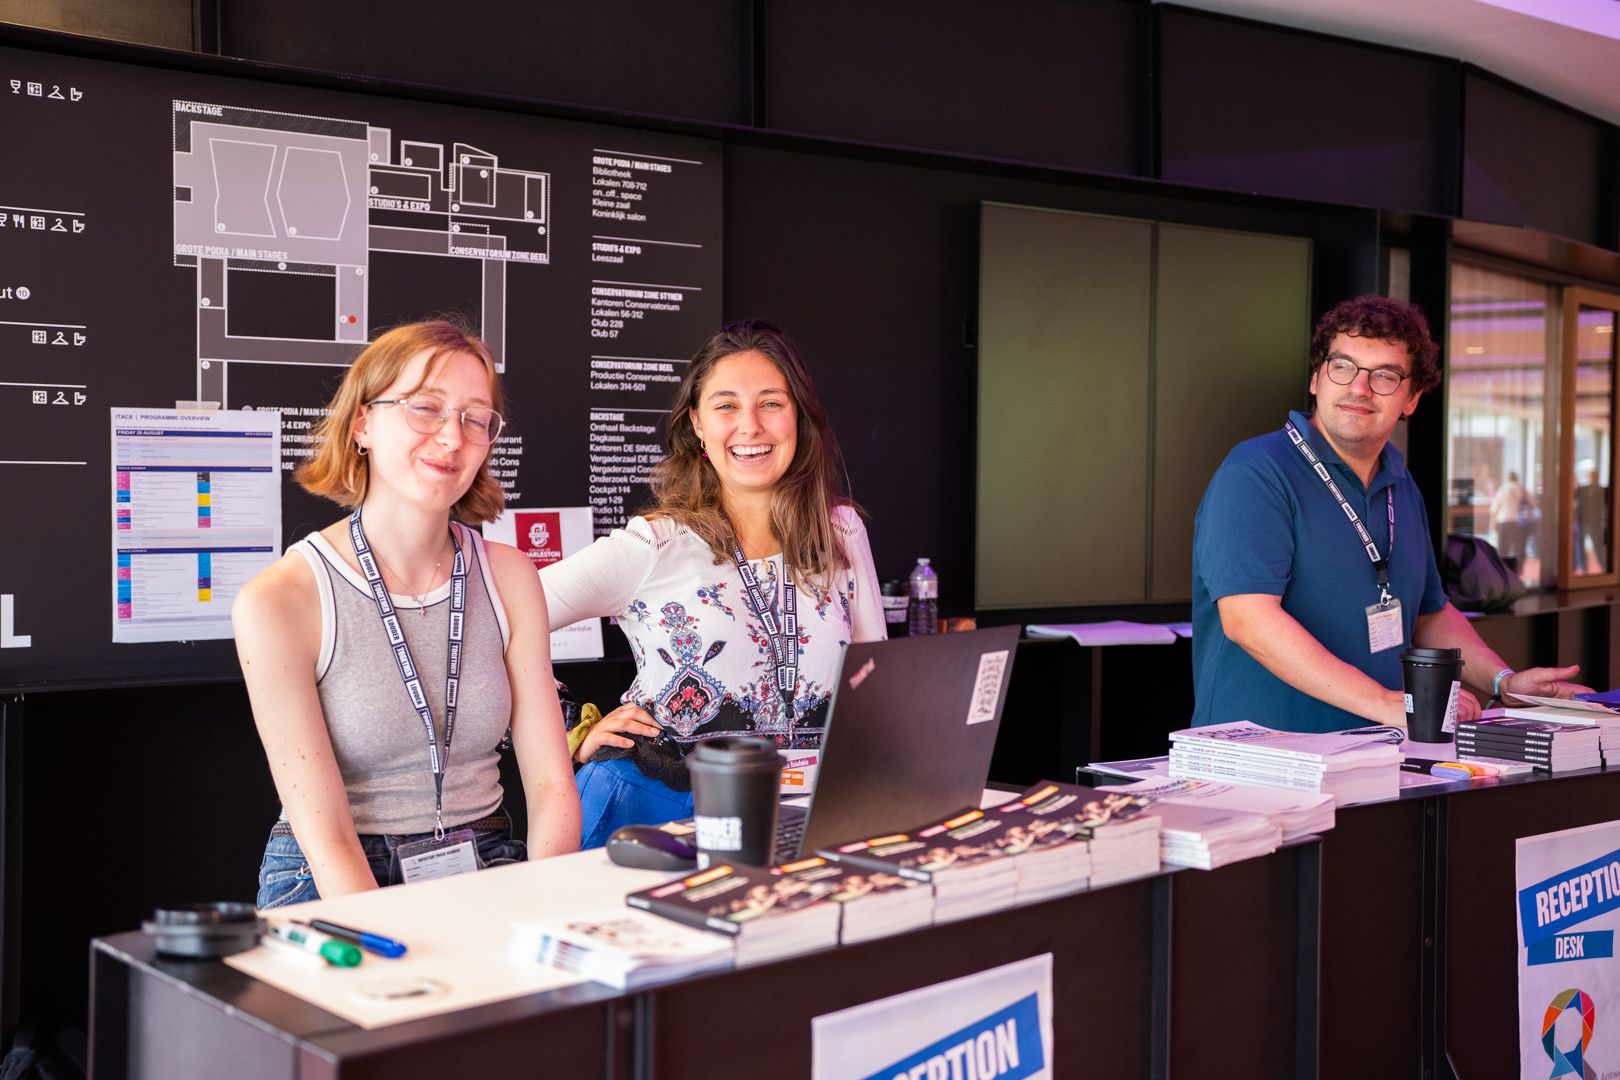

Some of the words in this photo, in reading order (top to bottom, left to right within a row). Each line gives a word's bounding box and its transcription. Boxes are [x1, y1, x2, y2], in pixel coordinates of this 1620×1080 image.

[175, 102, 223, 116] BACKSTAGE
[593, 156, 613, 166] GROTE
[614, 158, 630, 168] PODIA
[635, 161, 650, 171] MAIN
[650, 163, 672, 173] STAGES
[592, 167, 632, 178] Bibliotheek
[592, 177, 621, 187] Lokalen
[622, 180, 647, 190] 708-712
[620, 191, 642, 201] space
[369, 198, 401, 209] STUDIO'S
[402, 200, 410, 209] &
[410, 201, 430, 211] EXPO
[592, 198, 615, 208] Kleine
[616, 201, 630, 209] zaal
[592, 209, 625, 221] Koninklijk
[626, 213, 646, 221] salon
[176, 244, 203, 254] GROTE
[206, 245, 229, 256] PODIA
[236, 248, 256, 258] MAIN
[257, 250, 288, 260] STAGES
[451, 246, 511, 259] CONSERVATORIUM
[512, 251, 530, 260] ZONE
[619, 245, 625, 253] &
[625, 246, 641, 254] EXPO
[592, 253, 624, 263] Leeszaal
[591, 287, 643, 298] CONSERVATORIUM
[643, 291, 659, 299] ZONE
[591, 298, 624, 307] Kantoren
[625, 300, 680, 311] Conservatorium
[591, 308, 619, 317] Lokalen
[620, 310, 643, 319] 56-312
[591, 318, 609, 327] Club
[609, 320, 623, 328] 228
[591, 329, 608, 337] Club
[609, 330, 618, 338] 57
[591, 360, 642, 371] CONSERVATORIUM
[643, 363, 658, 371] ZONE
[590, 371, 624, 380] Productie
[625, 372, 681, 382] Conservatorium
[590, 381, 618, 390] Lokalen
[619, 382, 646, 391] 314-501
[280, 407, 298, 415] PODIA
[303, 408, 319, 416] MAIN
[590, 413, 624, 421] BACKSTAGE
[286, 421, 292, 429] &
[293, 421, 311, 429] EXPO
[590, 423, 618, 432] Onthaal
[619, 424, 656, 434] Backstage
[590, 433, 625, 443] Dagkassa
[281, 448, 314, 456] VATORIUM
[507, 447, 522, 455] zaal
[590, 444, 622, 452] Kantoren
[623, 445, 634, 453] DE
[635, 445, 663, 453] SINGEL
[499, 458, 520, 466] Cons
[590, 455, 637, 464] Vergaderzaal
[637, 455, 649, 463] DE
[281, 462, 295, 470] AGE
[590, 465, 637, 474] Vergaderzaal
[501, 469, 517, 477] zaal
[589, 475, 629, 483] Onderzoek
[589, 485, 618, 494] Cockpit
[618, 486, 631, 494] 1-14
[589, 496, 608, 505] Loge
[614, 506, 624, 514] 1-3
[1343, 504, 1356, 520] LOUDER
[1367, 545, 1379, 561] LOUDER
[362, 556, 376, 577] LOUDER
[742, 567, 754, 585] LOUDER
[373, 583, 390, 616] TOGETHER
[454, 582, 463, 608] TOGETHER
[786, 588, 794, 611] TOGETHER
[0, 593, 32, 649] L
[452, 615, 460, 637] LOUDER
[764, 614, 776, 633] LOUDER
[387, 618, 400, 641] LOUDER
[787, 639, 795, 664] TOGETHER
[396, 646, 413, 678] TOGETHER
[450, 644, 459, 675] TOGETHER
[410, 683, 422, 705] LOUDER
[1555, 935, 1585, 960] DESK
